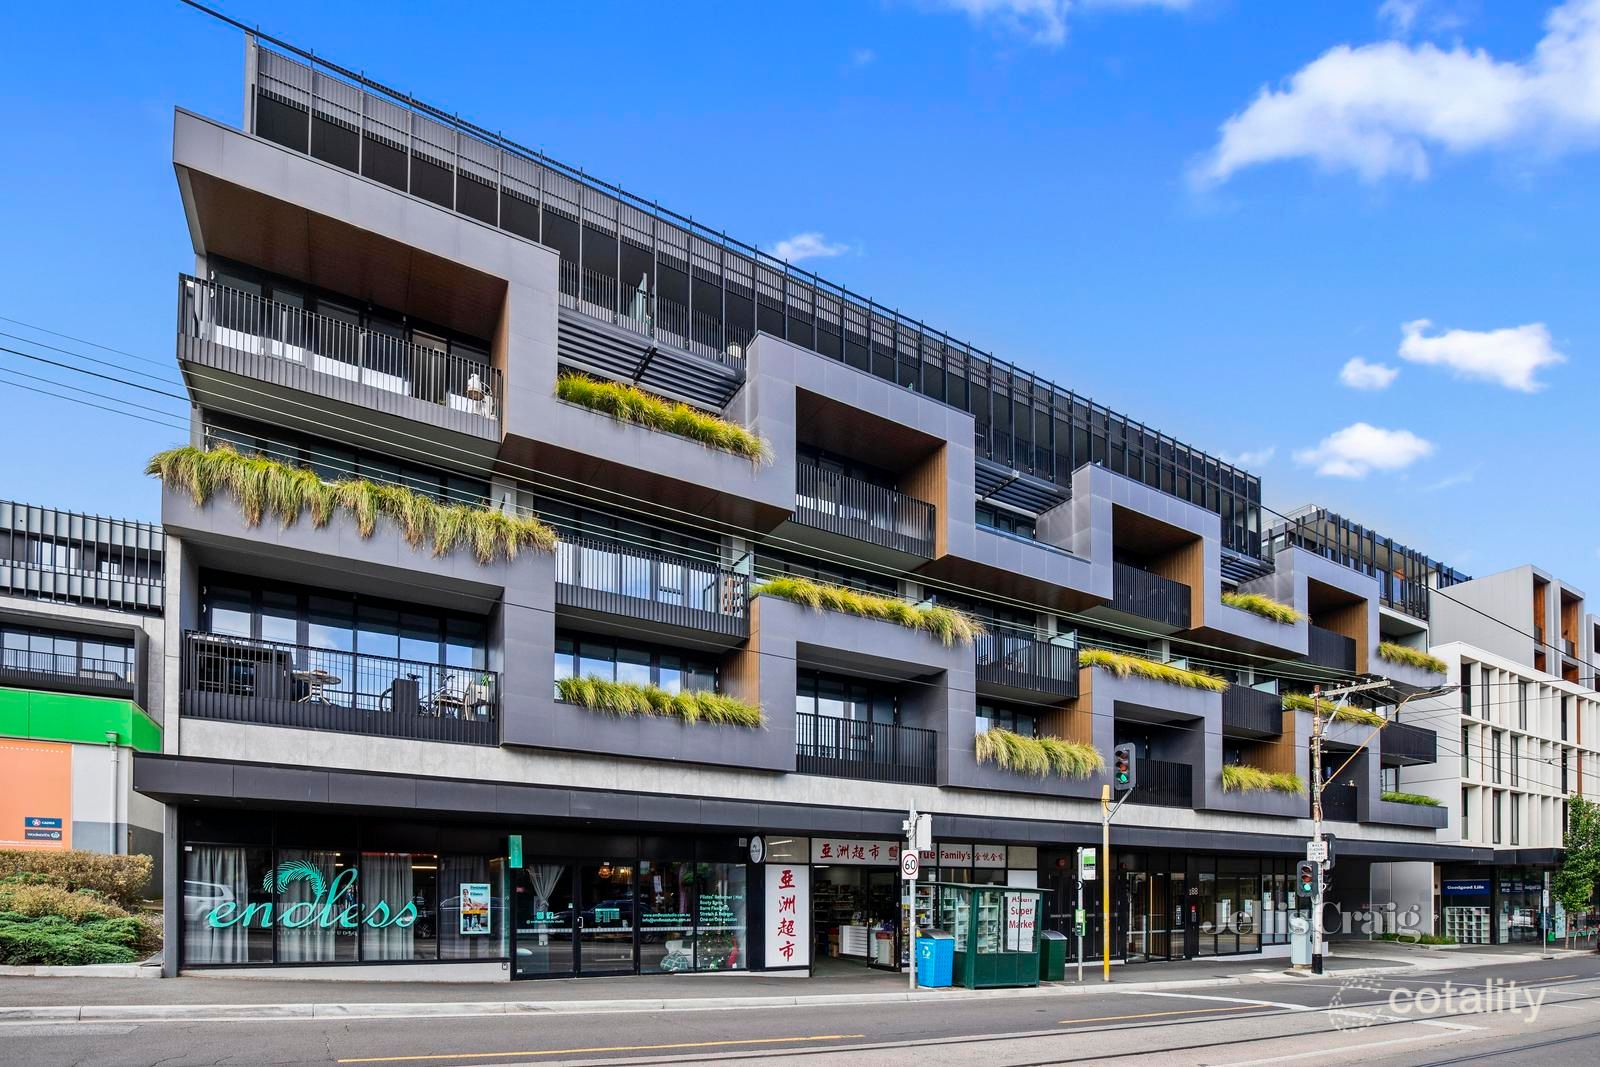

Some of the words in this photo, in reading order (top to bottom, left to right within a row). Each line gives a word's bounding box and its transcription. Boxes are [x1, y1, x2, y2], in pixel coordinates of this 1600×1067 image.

[940, 850, 971, 862] Family's
[904, 859, 916, 870] 60
[205, 860, 418, 928] endless
[1010, 906, 1033, 917] Super
[1009, 919, 1037, 929] Market
